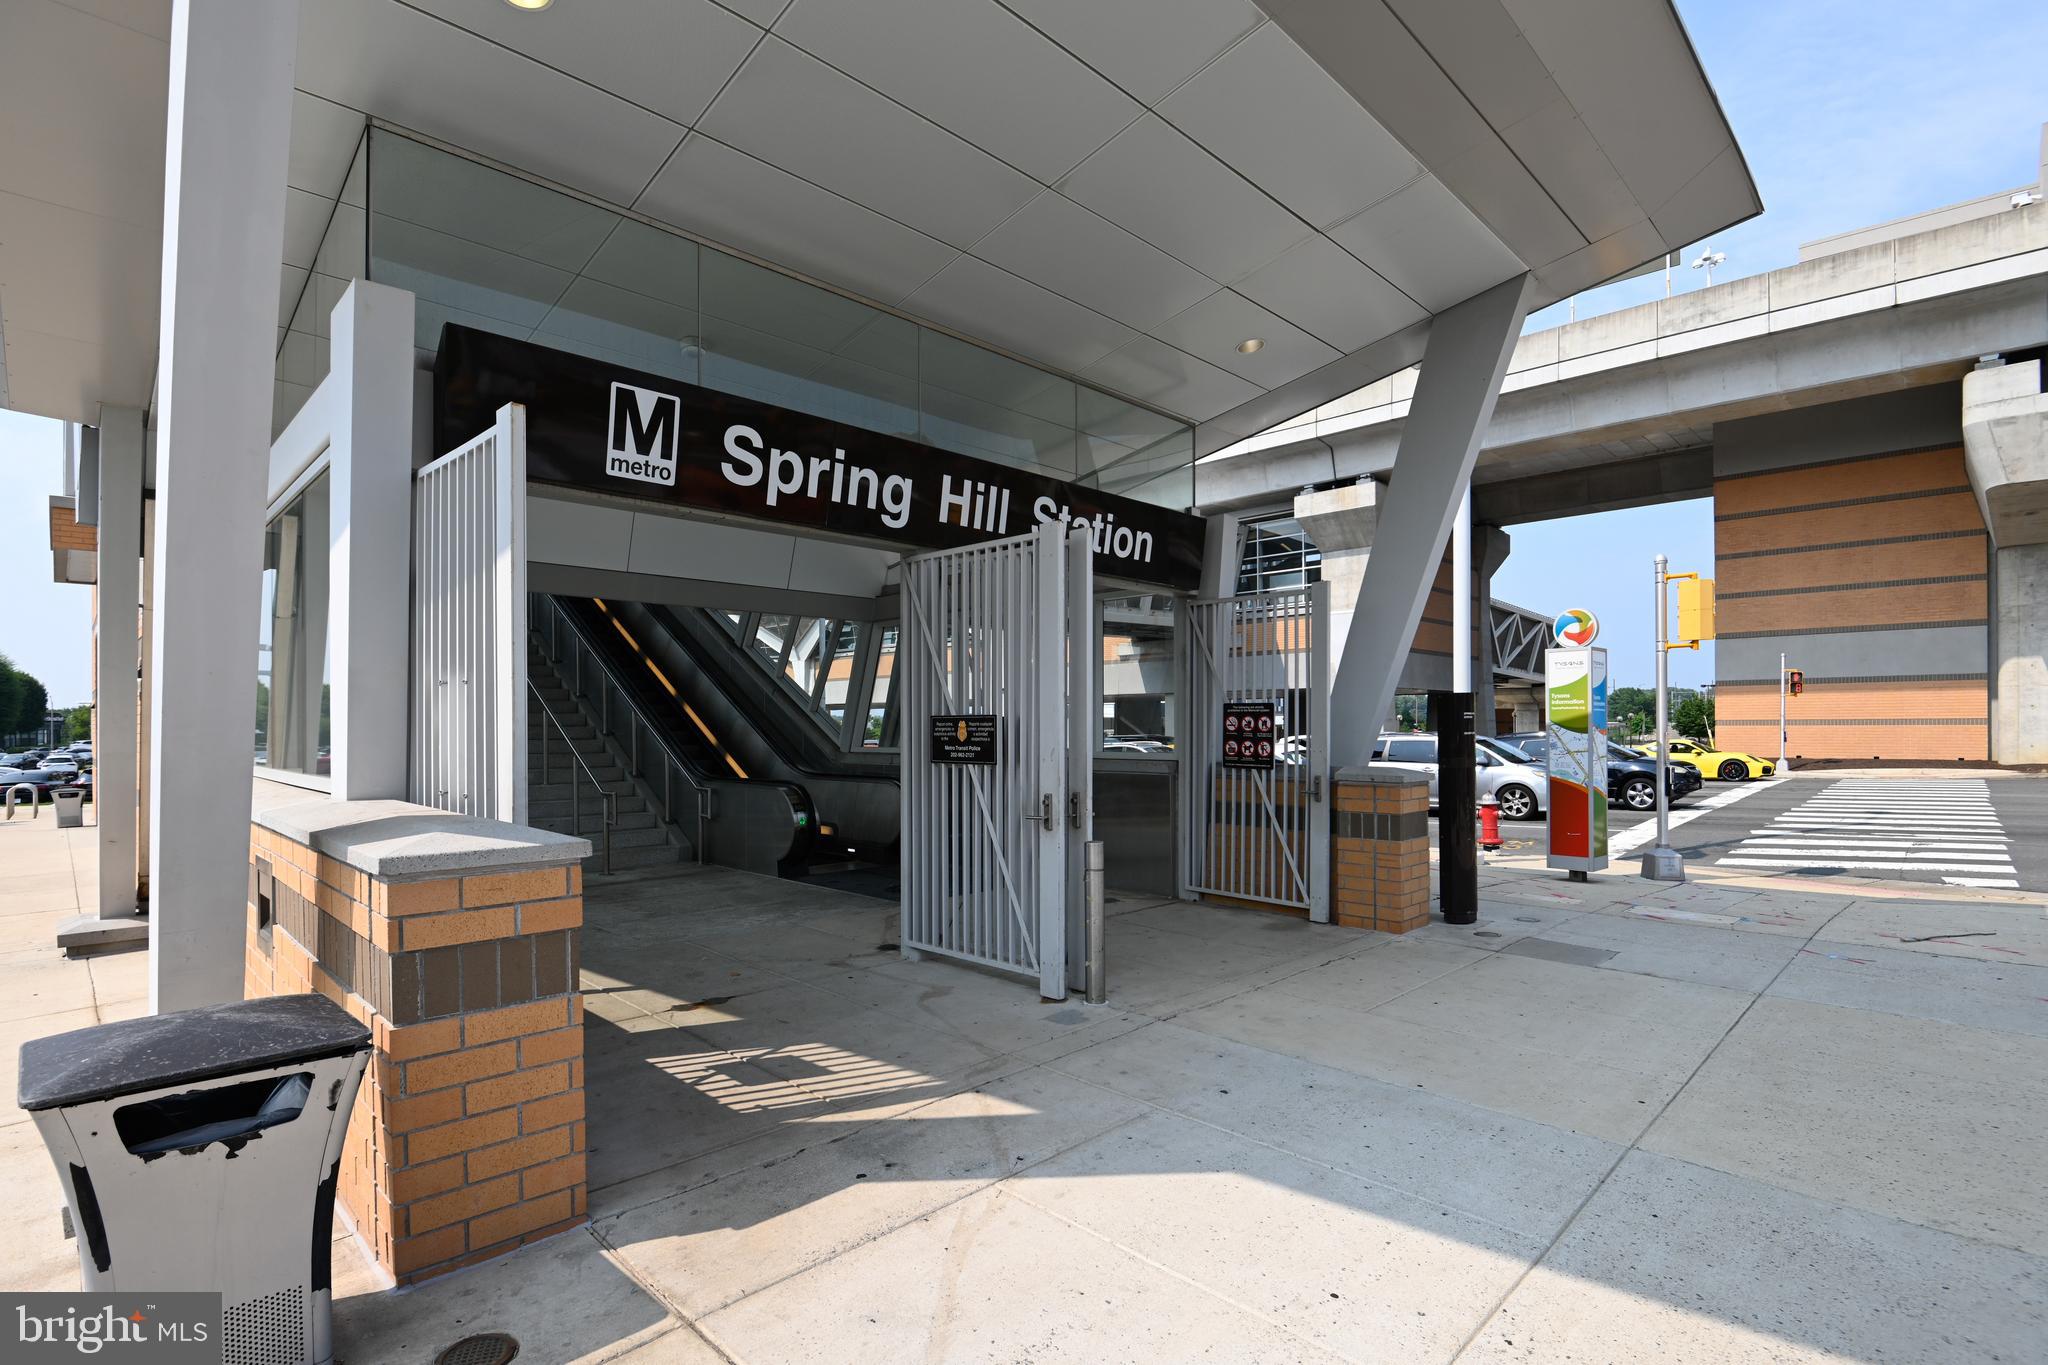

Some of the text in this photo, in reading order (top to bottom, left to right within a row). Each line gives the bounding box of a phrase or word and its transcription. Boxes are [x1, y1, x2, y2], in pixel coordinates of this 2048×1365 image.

[612, 386, 676, 461] M
[610, 457, 671, 480] metro
[721, 424, 913, 528] Spring
[938, 474, 1010, 535] Hill
